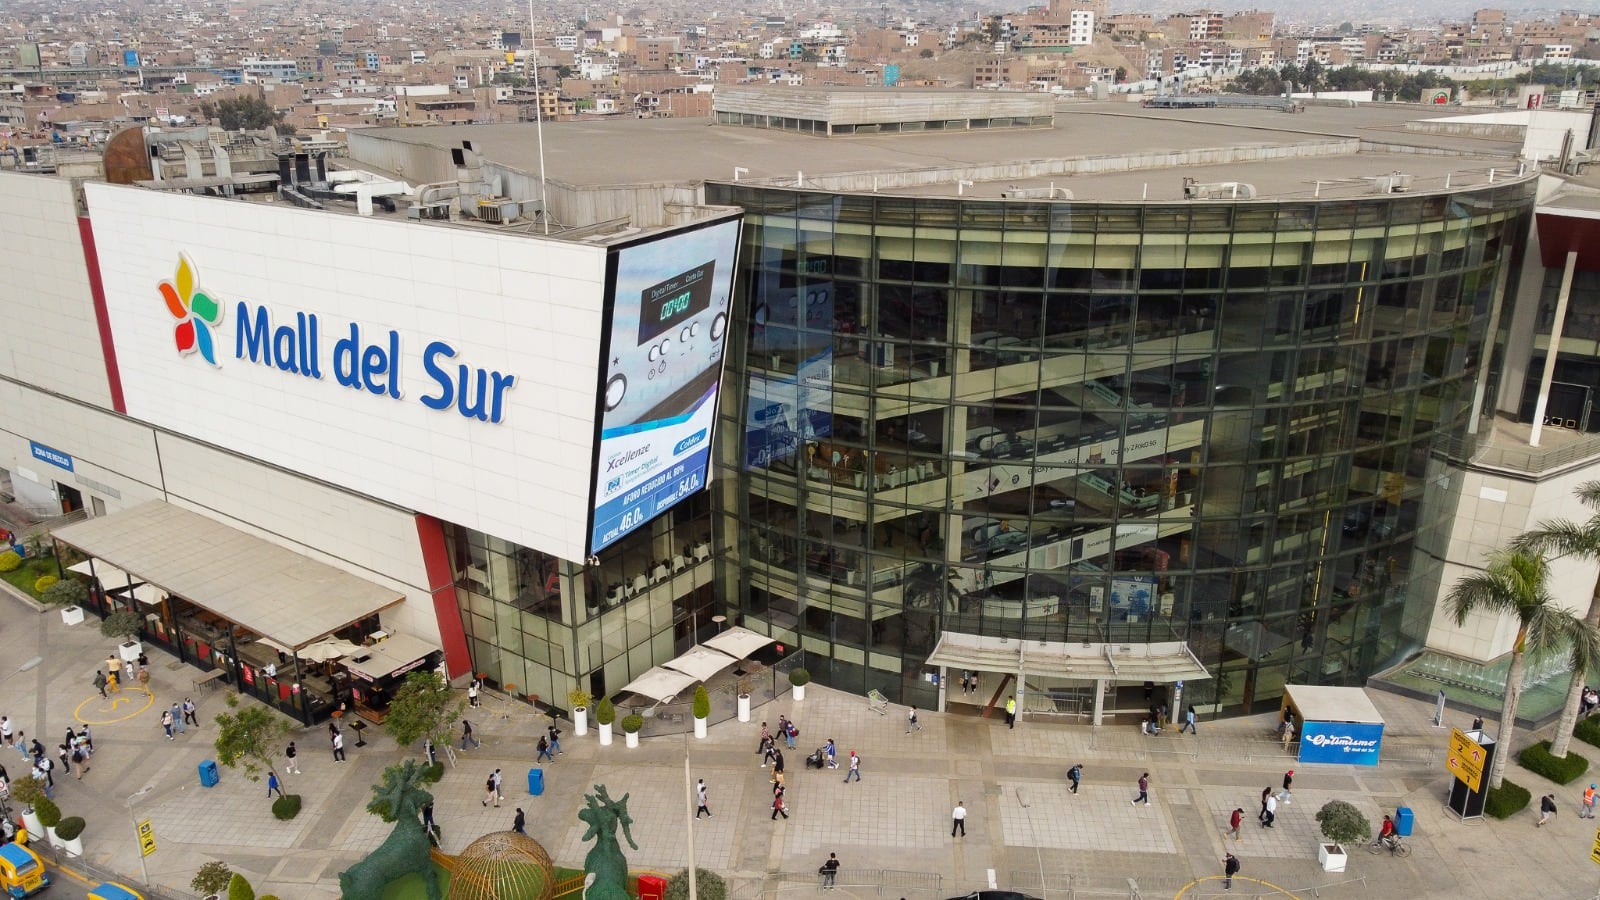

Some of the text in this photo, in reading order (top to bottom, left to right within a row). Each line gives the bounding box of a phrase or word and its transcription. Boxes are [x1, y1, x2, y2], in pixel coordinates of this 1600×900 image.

[236, 301, 515, 423] Mall del Sur
[606, 443, 651, 472] Xcellenze
[623, 488, 641, 506] AFORO
[602, 527, 619, 544] ACTUAL
[1305, 734, 1378, 748] Optimismo
[1457, 744, 1463, 753] 2
[1466, 775, 1471, 783] 1
